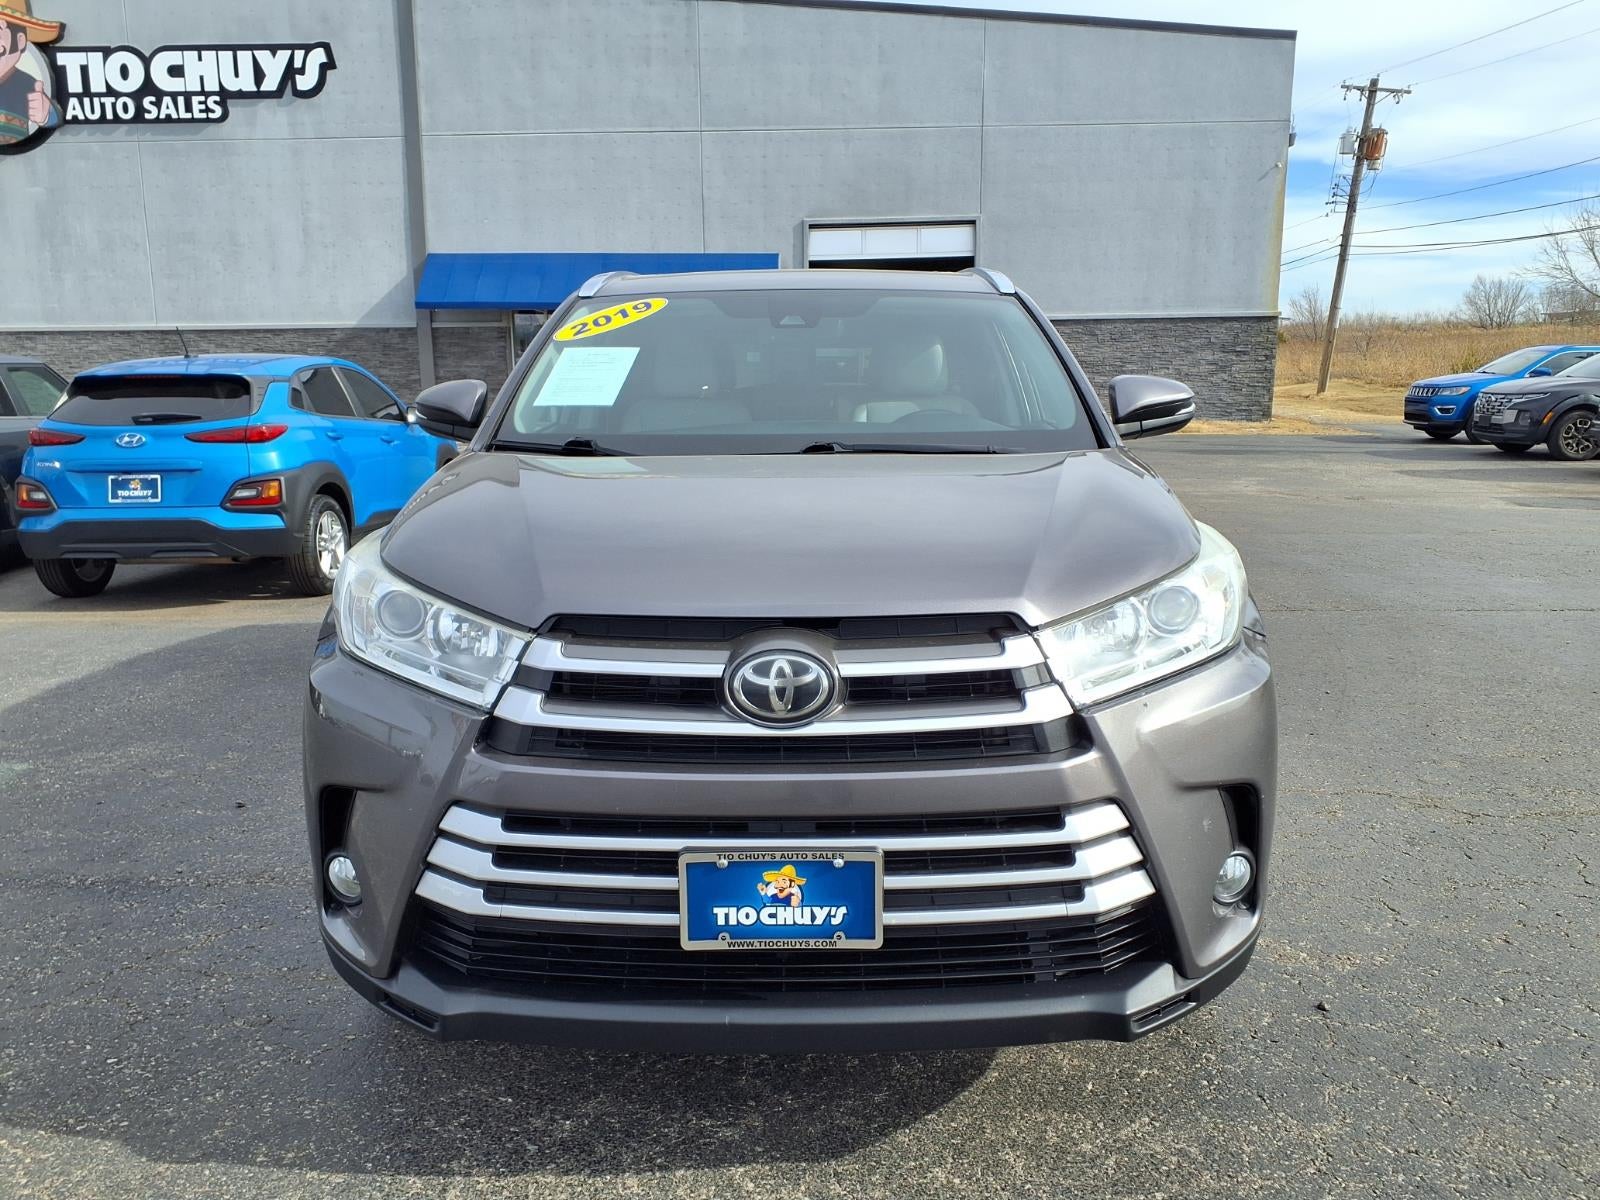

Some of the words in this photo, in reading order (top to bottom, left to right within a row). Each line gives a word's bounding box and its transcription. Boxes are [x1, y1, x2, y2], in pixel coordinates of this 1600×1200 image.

[56, 50, 146, 94] TIO
[150, 47, 328, 93] CHUY'S
[65, 96, 136, 121] AUTO
[143, 95, 223, 120] SALES
[570, 301, 653, 337] 2019
[716, 853, 734, 861] TIO
[737, 853, 777, 861] CHUY'S
[779, 852, 809, 860] AUTO
[811, 852, 845, 860] SALES
[727, 940, 838, 948] WWW.TIOCHUYS.COM
